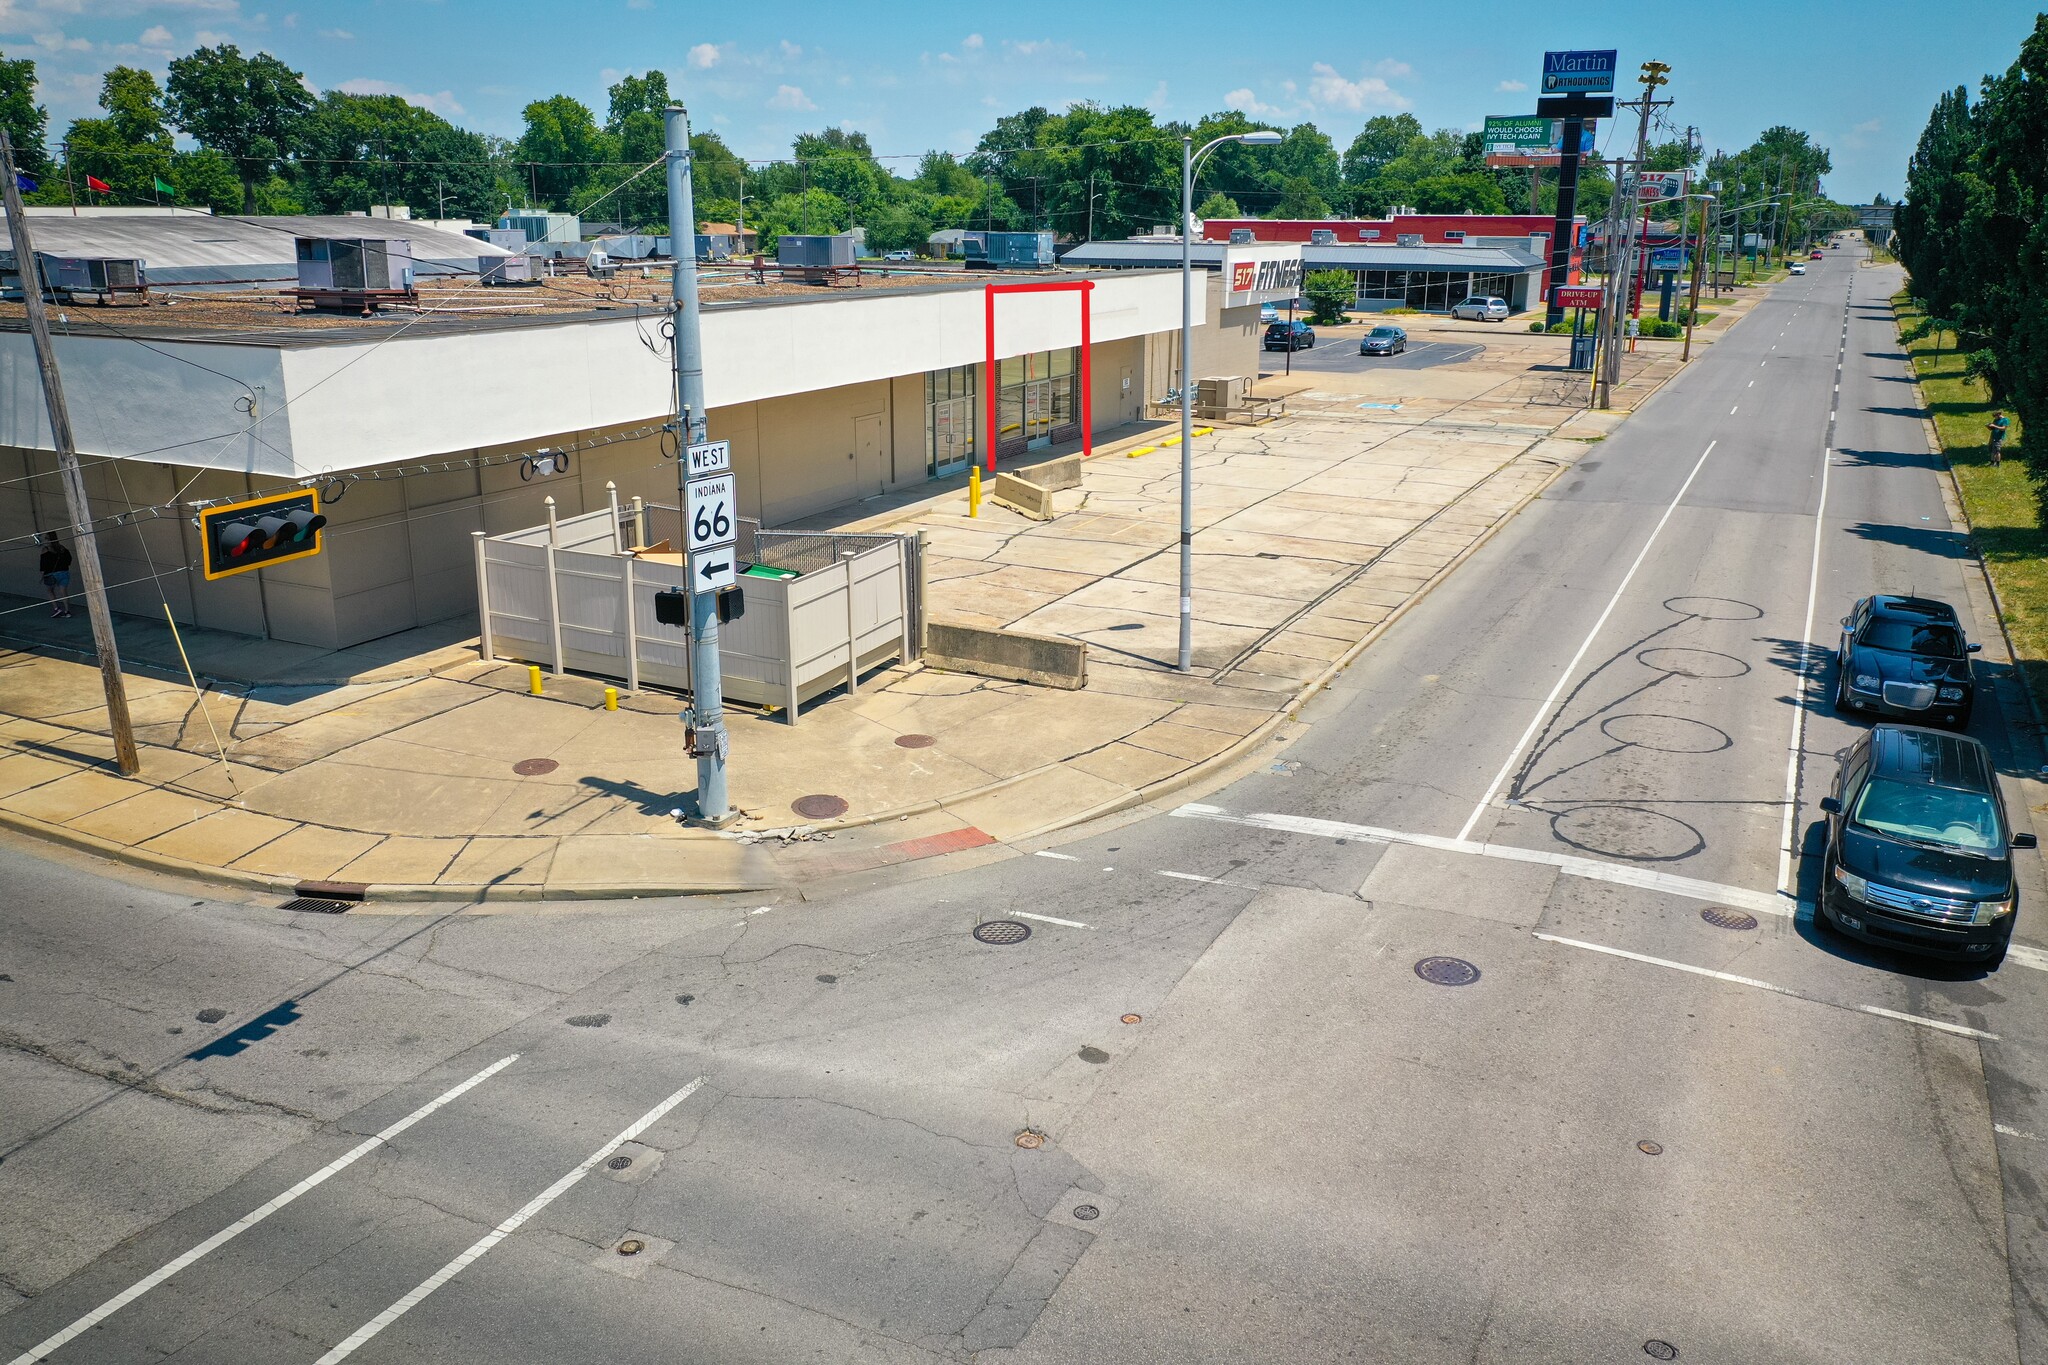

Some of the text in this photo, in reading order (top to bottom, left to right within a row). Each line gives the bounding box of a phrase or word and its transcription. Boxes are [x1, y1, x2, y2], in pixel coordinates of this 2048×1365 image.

[1550, 54, 1607, 71] Martin
[1234, 259, 1305, 291] 517 FITNESS
[692, 447, 724, 468] WEST
[695, 483, 726, 498] INDIANA
[694, 501, 730, 541] 66
